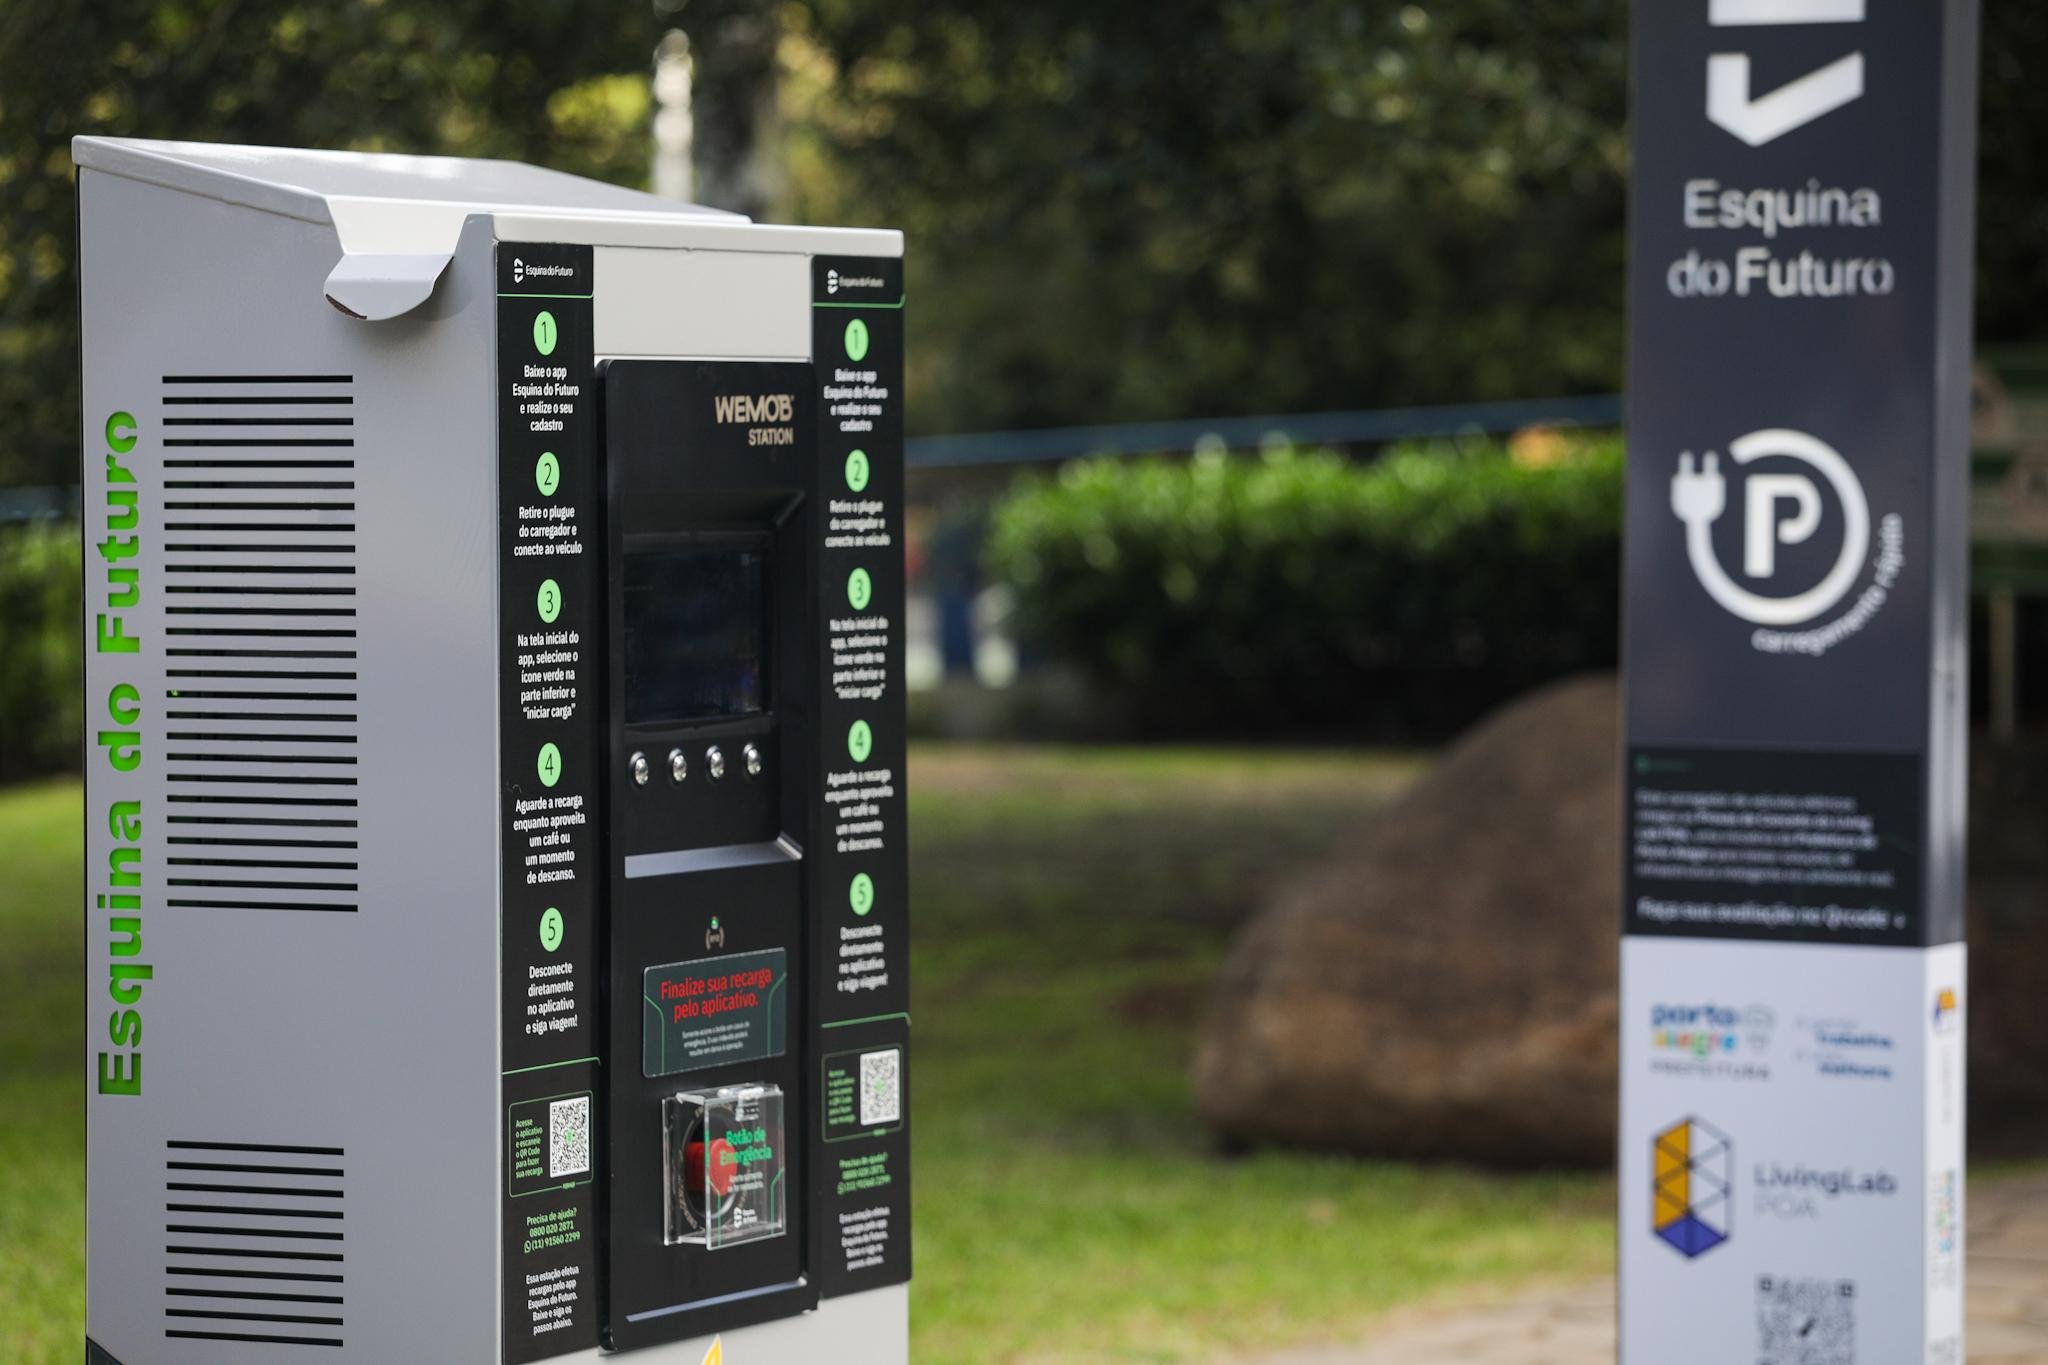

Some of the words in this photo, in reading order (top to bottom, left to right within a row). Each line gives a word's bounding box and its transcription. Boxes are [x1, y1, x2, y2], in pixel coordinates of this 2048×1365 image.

[1684, 178, 1881, 238] Esquina
[1667, 248, 1731, 297] do
[1736, 247, 1894, 297] Futuro
[524, 365, 545, 378] Baixe
[546, 368, 551, 378] o
[552, 367, 567, 381] app
[513, 383, 542, 398] Esquina
[544, 383, 553, 396] do
[555, 384, 579, 396] Futuro
[520, 404, 525, 414] e
[527, 401, 552, 414] realize
[553, 404, 558, 414] o
[559, 404, 573, 414] seu
[530, 418, 563, 431] cadastro
[749, 428, 793, 446] STATION
[519, 505, 541, 519] Retire
[543, 508, 548, 518] o
[549, 505, 575, 520] plugue
[99, 412, 141, 654] Futuro
[519, 524, 529, 537] do
[530, 523, 570, 539] carregador
[571, 525, 577, 535] e
[1744, 474, 1822, 578] P
[514, 543, 544, 556] conecte
[545, 544, 555, 555] ao
[555, 541, 583, 554] veículo
[517, 634, 528, 647] Na
[530, 633, 544, 646] tela
[545, 631, 568, 645] inicial
[569, 631, 579, 643] do
[518, 654, 535, 667] app,
[536, 650, 571, 664] selecione
[573, 652, 578, 662] o
[521, 670, 542, 683] ícone
[543, 668, 564, 682] verde
[565, 670, 575, 680] na
[521, 689, 541, 704] parte
[542, 686, 570, 700] inferior
[570, 688, 576, 698] e
[99, 684, 142, 773] do
[516, 797, 547, 815] Aguarde
[548, 799, 553, 809] a
[555, 795, 583, 809] recarga
[513, 816, 549, 832] enquanto
[550, 811, 586, 829] aproveita
[529, 837, 541, 847] um
[543, 831, 559, 846] café
[560, 833, 570, 844] ou
[525, 856, 537, 866] um
[539, 850, 575, 864] momento
[527, 871, 537, 884] de
[538, 869, 575, 882] descanso.
[99, 802, 153, 1096] Esquina
[529, 962, 573, 978] Desconecte
[528, 980, 574, 997] diretamente
[660, 977, 705, 1000] Finalize
[707, 976, 728, 992] sua
[730, 968, 773, 990] recarga
[527, 1004, 537, 1015] no
[538, 997, 574, 1016] aplicativo
[674, 999, 700, 1024] pelo
[701, 990, 759, 1018] aplicativo.
[526, 1023, 531, 1034] e
[532, 1020, 548, 1035] siga
[549, 1014, 578, 1032] viagem!
[1651, 1003, 1739, 1029] porto
[1653, 1031, 1738, 1058] alegre
[516, 1119, 533, 1128] Acesse
[520, 1127, 543, 1138] aplicativo
[726, 1129, 753, 1145] Botão
[754, 1126, 766, 1142] de
[520, 1149, 527, 1159] QR
[528, 1147, 540, 1156] Code
[720, 1144, 772, 1167] Emergência
[516, 1160, 527, 1169] para
[527, 1157, 539, 1166] fazer
[516, 1170, 525, 1178] sua
[525, 1167, 543, 1176] recarga
[1753, 1164, 1898, 1199] LivingLab
[527, 1214, 548, 1226] Precisa
[549, 1211, 557, 1221] de
[557, 1207, 577, 1220] ajuda?
[529, 1226, 545, 1238] 0800
[546, 1223, 558, 1235] 020
[559, 1220, 573, 1231] 2871
[532, 1238, 544, 1251] (11)
[545, 1234, 564, 1247] 91560
[565, 1231, 580, 1243] 2299
[526, 1274, 539, 1284] Essa
[540, 1269, 561, 1281] estação
[561, 1266, 580, 1277] efetua
[529, 1284, 552, 1297] recargas
[553, 1280, 565, 1293] pelo
[566, 1279, 576, 1290] app
[528, 1297, 549, 1310] Esquina
[550, 1294, 557, 1305] do
[558, 1292, 578, 1303] Futuro.
[533, 1310, 548, 1321] Baixe
[553, 1306, 565, 1318] siga
[565, 1305, 573, 1314] os
[534, 1322, 552, 1336] passos
[553, 1317, 573, 1330] abaixo.
